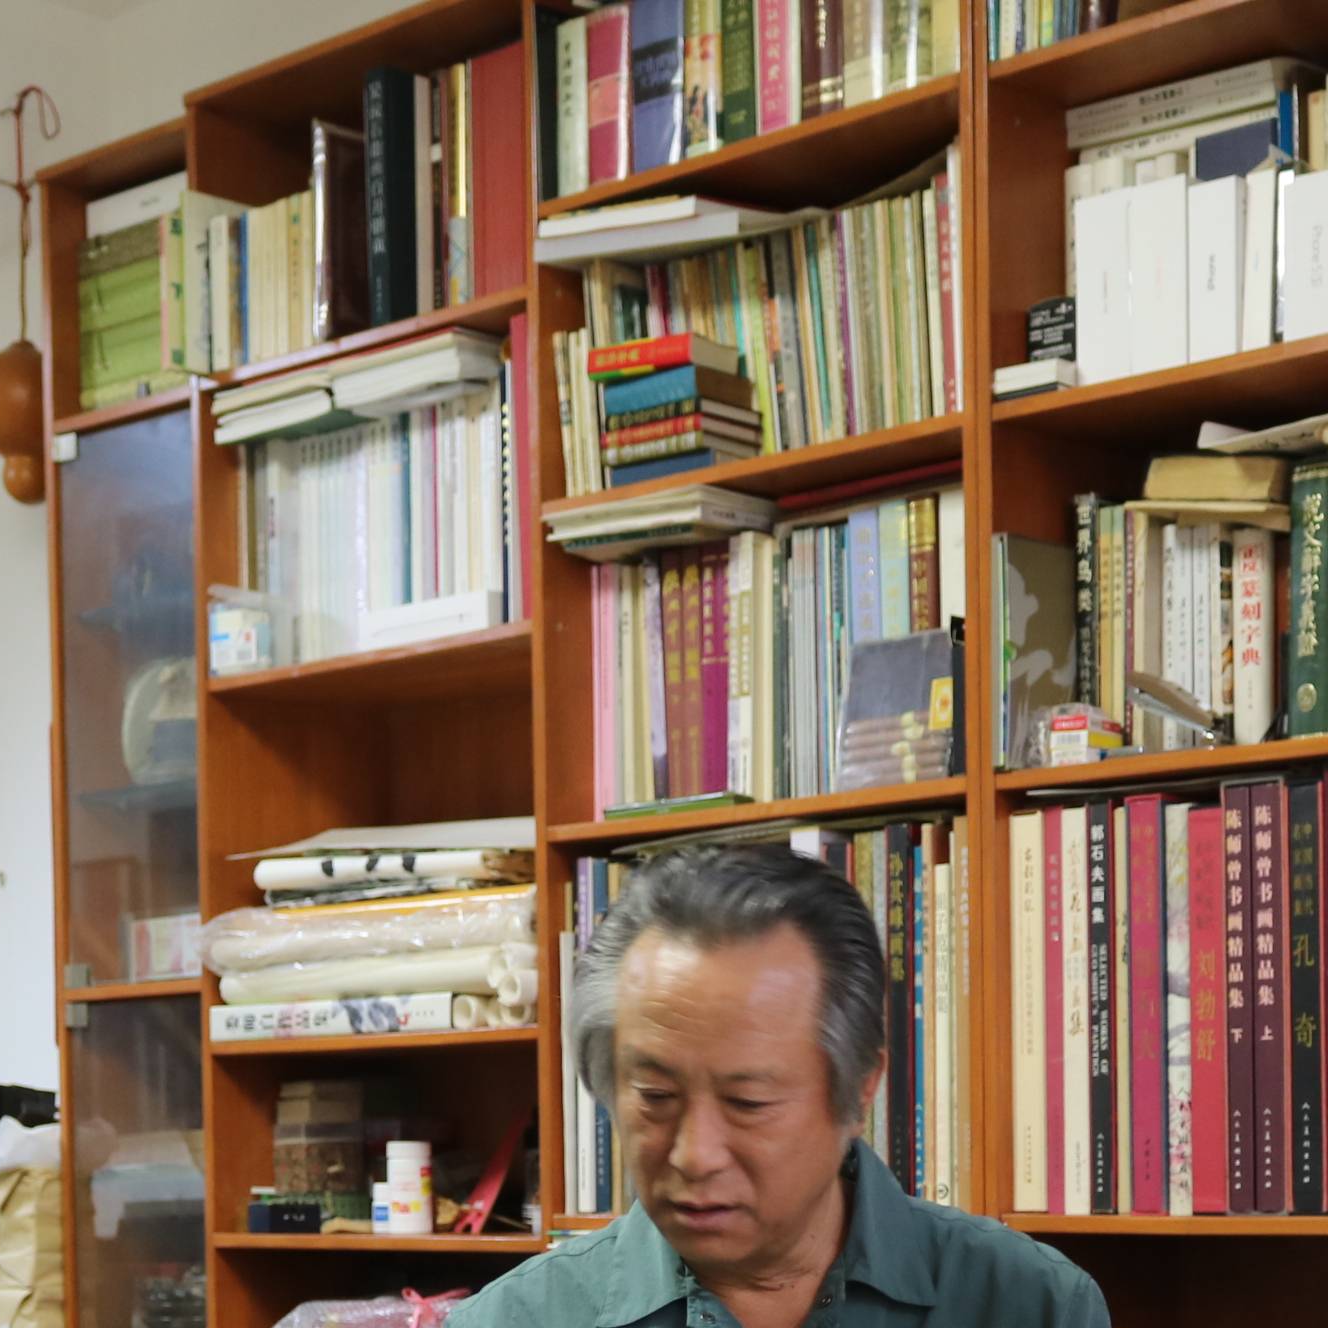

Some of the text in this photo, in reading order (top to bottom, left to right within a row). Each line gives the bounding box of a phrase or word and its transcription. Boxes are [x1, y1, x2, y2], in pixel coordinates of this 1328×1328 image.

[1090, 824, 1105, 924] 郭石夫画集
[1226, 808, 1245, 1044] 陈师曾书画精品集 下
[1254, 804, 1276, 1042] 陈师曾书画精品集 上
[1196, 949, 1216, 1061] 刘勃舒
[1293, 934, 1317, 1048] 孔奇
